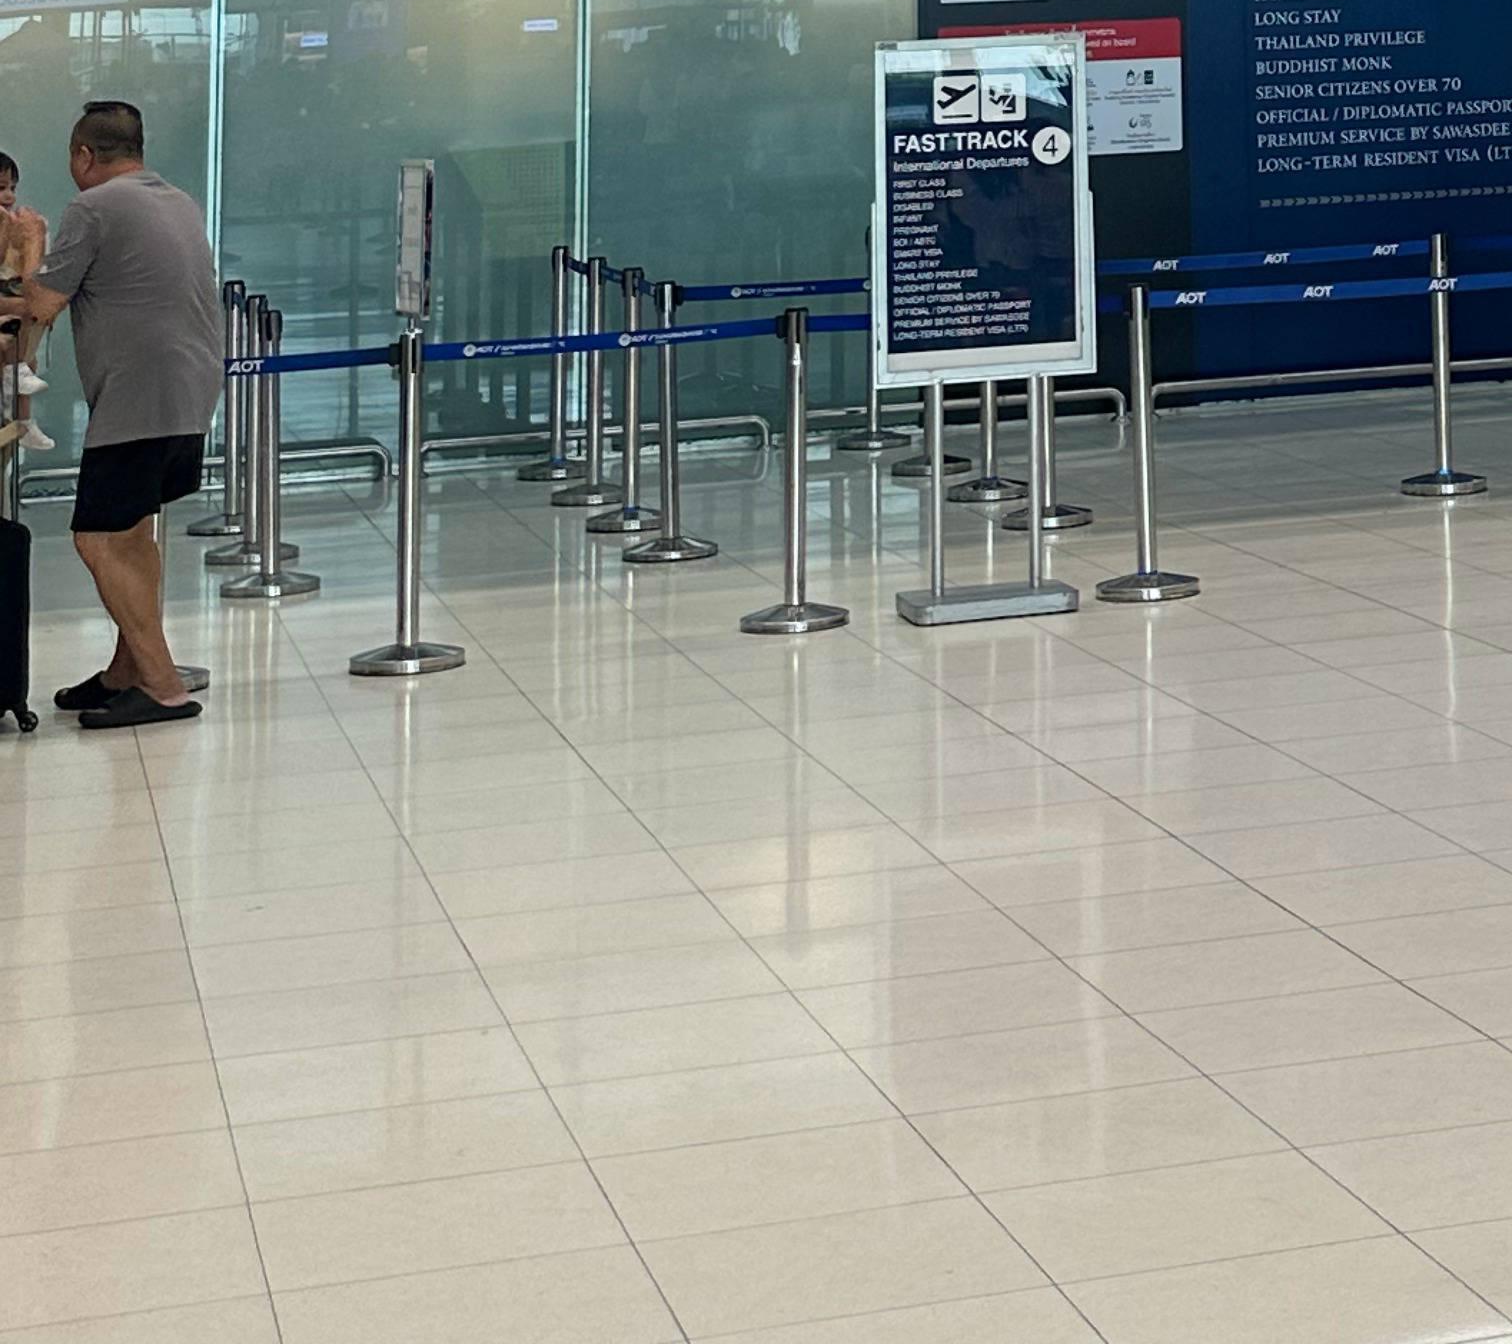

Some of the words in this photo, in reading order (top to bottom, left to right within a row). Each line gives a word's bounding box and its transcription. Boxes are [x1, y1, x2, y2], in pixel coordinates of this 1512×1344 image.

[1254, 12, 1299, 26] LONG
[1303, 10, 1341, 24] STAY
[1255, 34, 1339, 50] THAILAND
[1344, 30, 1425, 47] PRIVILEGE
[1256, 59, 1338, 75] BUDDHIST
[1342, 56, 1392, 71] MONK
[1256, 85, 1313, 100] SENIOR
[1318, 80, 1390, 96] CITIZENS
[1394, 78, 1438, 93] OVER
[1442, 77, 1461, 91] 70
[1256, 108, 1329, 124] OFFICIAL
[1343, 102, 1443, 120] DIPLOMATIC
[893, 133, 949, 154] FAST
[952, 129, 1029, 151] TRACK
[1042, 134, 1058, 157] 4
[1257, 132, 1334, 148] PREMIUM
[1340, 128, 1405, 144] SERVICE
[1410, 126, 1429, 141] BY
[1432, 123, 1511, 139] SAWASDEE
[893, 158, 964, 173] International
[966, 156, 1029, 170] Departures
[1258, 154, 1357, 172] LONG-TERM
[1364, 150, 1439, 167] RESIDENT
[1445, 148, 1480, 162] VISA
[1373, 243, 1399, 256] AOT
[1152, 259, 1179, 271] AOT
[1263, 252, 1290, 265] AOT
[1303, 285, 1333, 300] AOT
[1428, 277, 1458, 292] AOT
[1175, 291, 1208, 305] AOT
[227, 359, 265, 375] AOT
